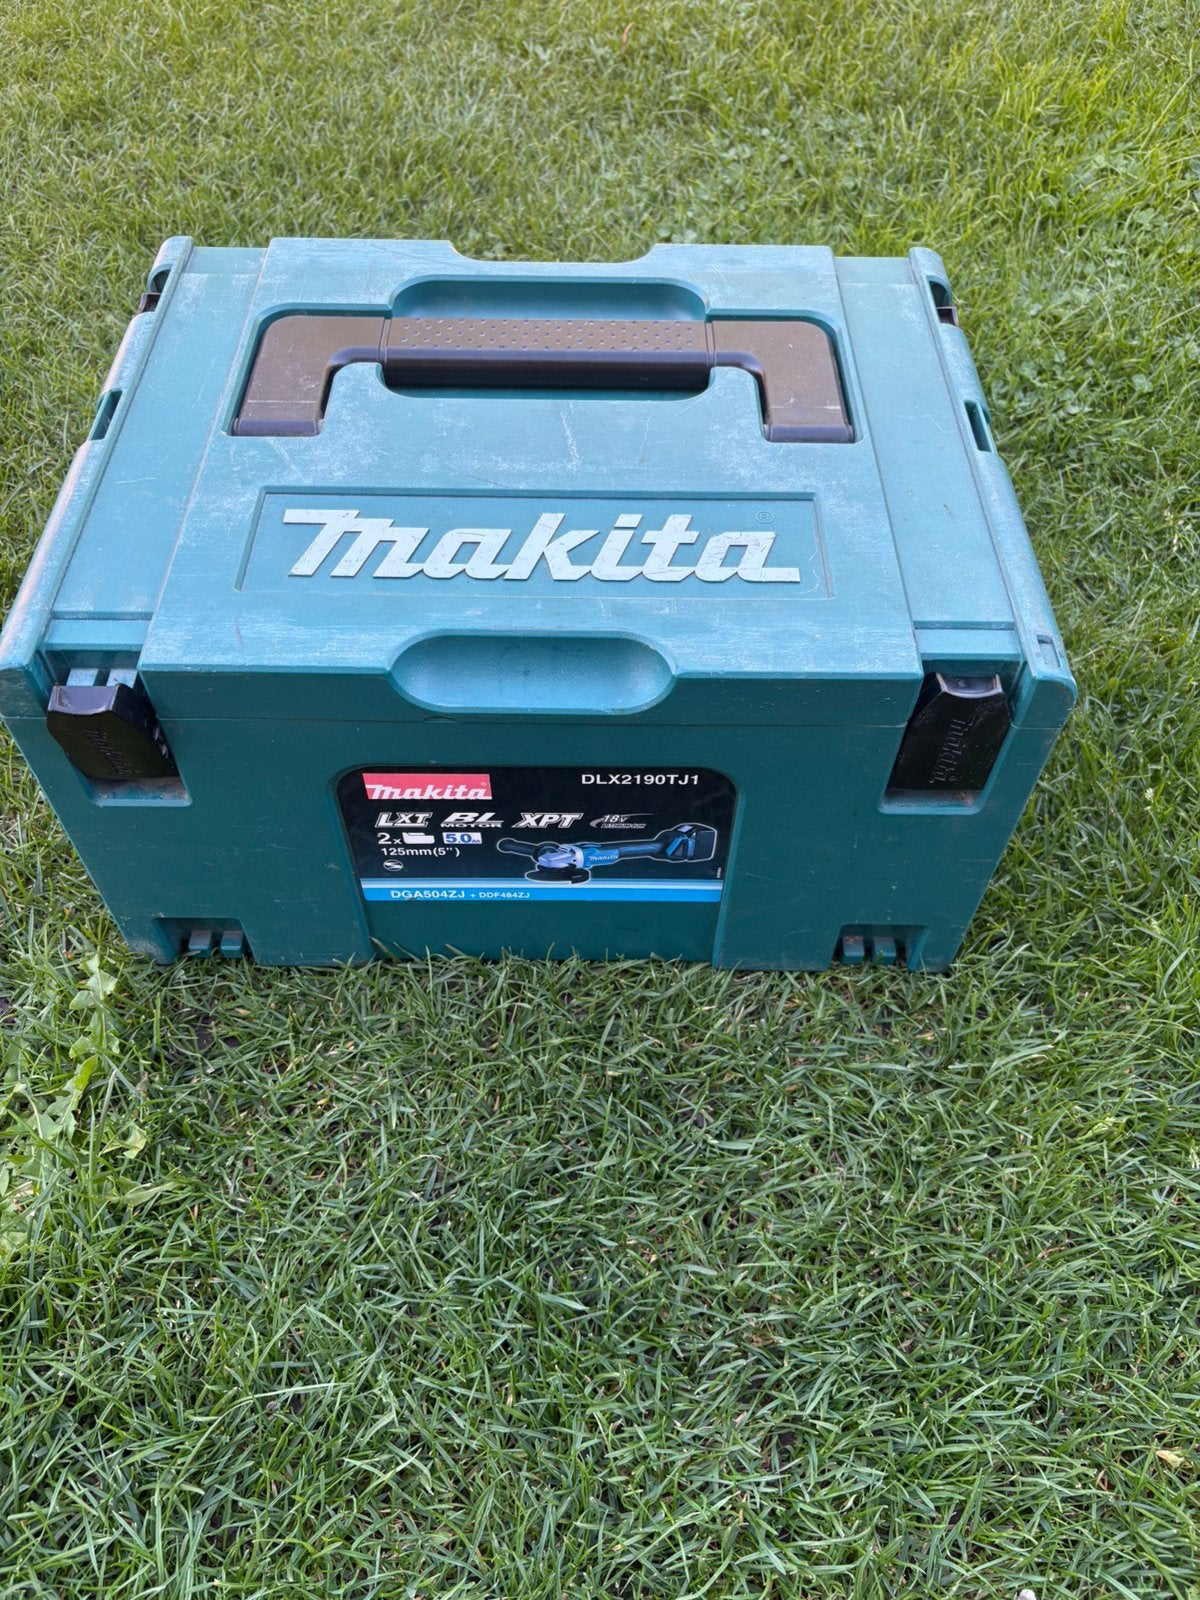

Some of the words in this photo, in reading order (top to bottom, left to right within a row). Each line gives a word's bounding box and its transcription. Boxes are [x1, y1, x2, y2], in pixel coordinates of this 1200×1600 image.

[283, 508, 800, 583] makita
[581, 774, 699, 785] DLX2190TJ1
[364, 784, 493, 800] makita
[375, 812, 433, 828] LXT
[441, 812, 504, 824] BL
[511, 813, 584, 828] XPT
[390, 890, 465, 899] DGA504ZJ
